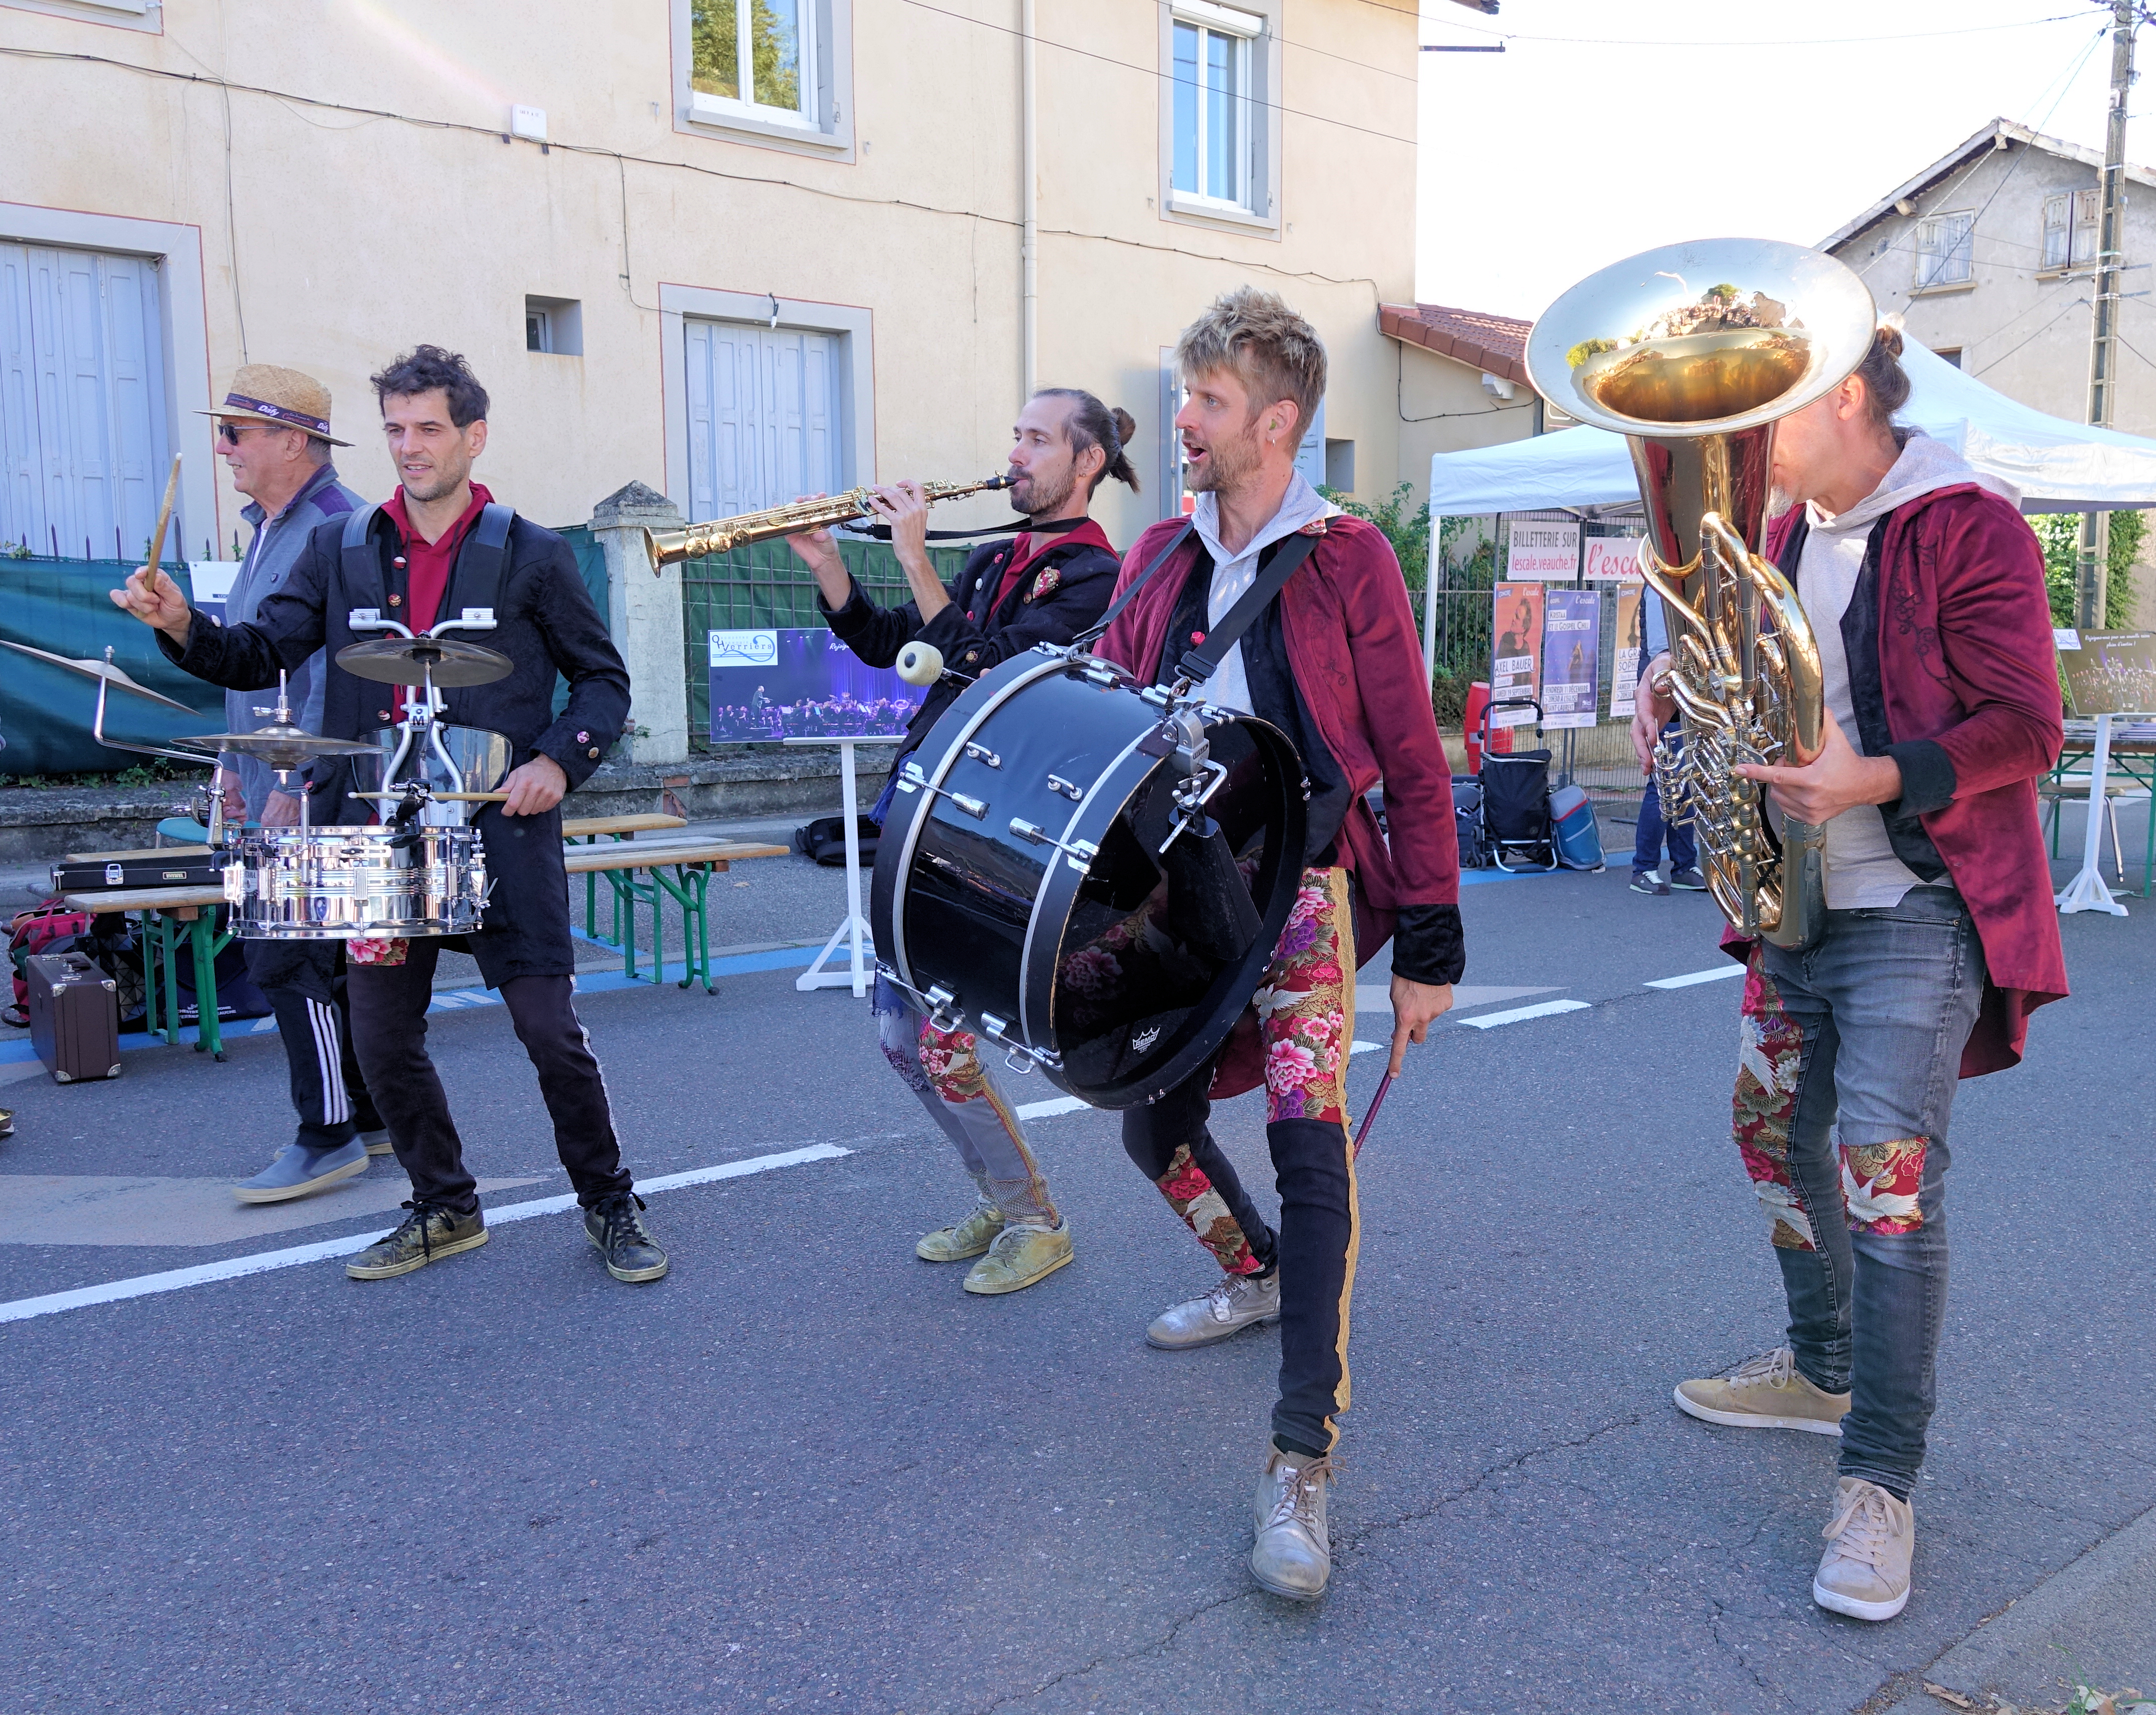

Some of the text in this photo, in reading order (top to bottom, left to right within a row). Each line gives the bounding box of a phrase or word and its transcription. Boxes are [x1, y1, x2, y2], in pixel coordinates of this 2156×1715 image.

[258, 405, 280, 416] Dafy
[1513, 531, 1577, 548] BILLETTERIE SUR
[1512, 554, 1577, 571] lescale.veauche.fr
[1587, 543, 1641, 575] l'esca
[1575, 595, 1595, 604] l'escale
[1559, 622, 1575, 630] GOSPEL
[723, 642, 772, 652] Verriers
[1618, 649, 1640, 659] LA GRA
[1494, 658, 1535, 677] AXEL BAUER
[1618, 661, 1637, 672] SOPHI
[1512, 687, 1532, 696] SEPTEMBRE
[413, 715, 424, 726] M
[1135, 1034, 1155, 1047] REMO
